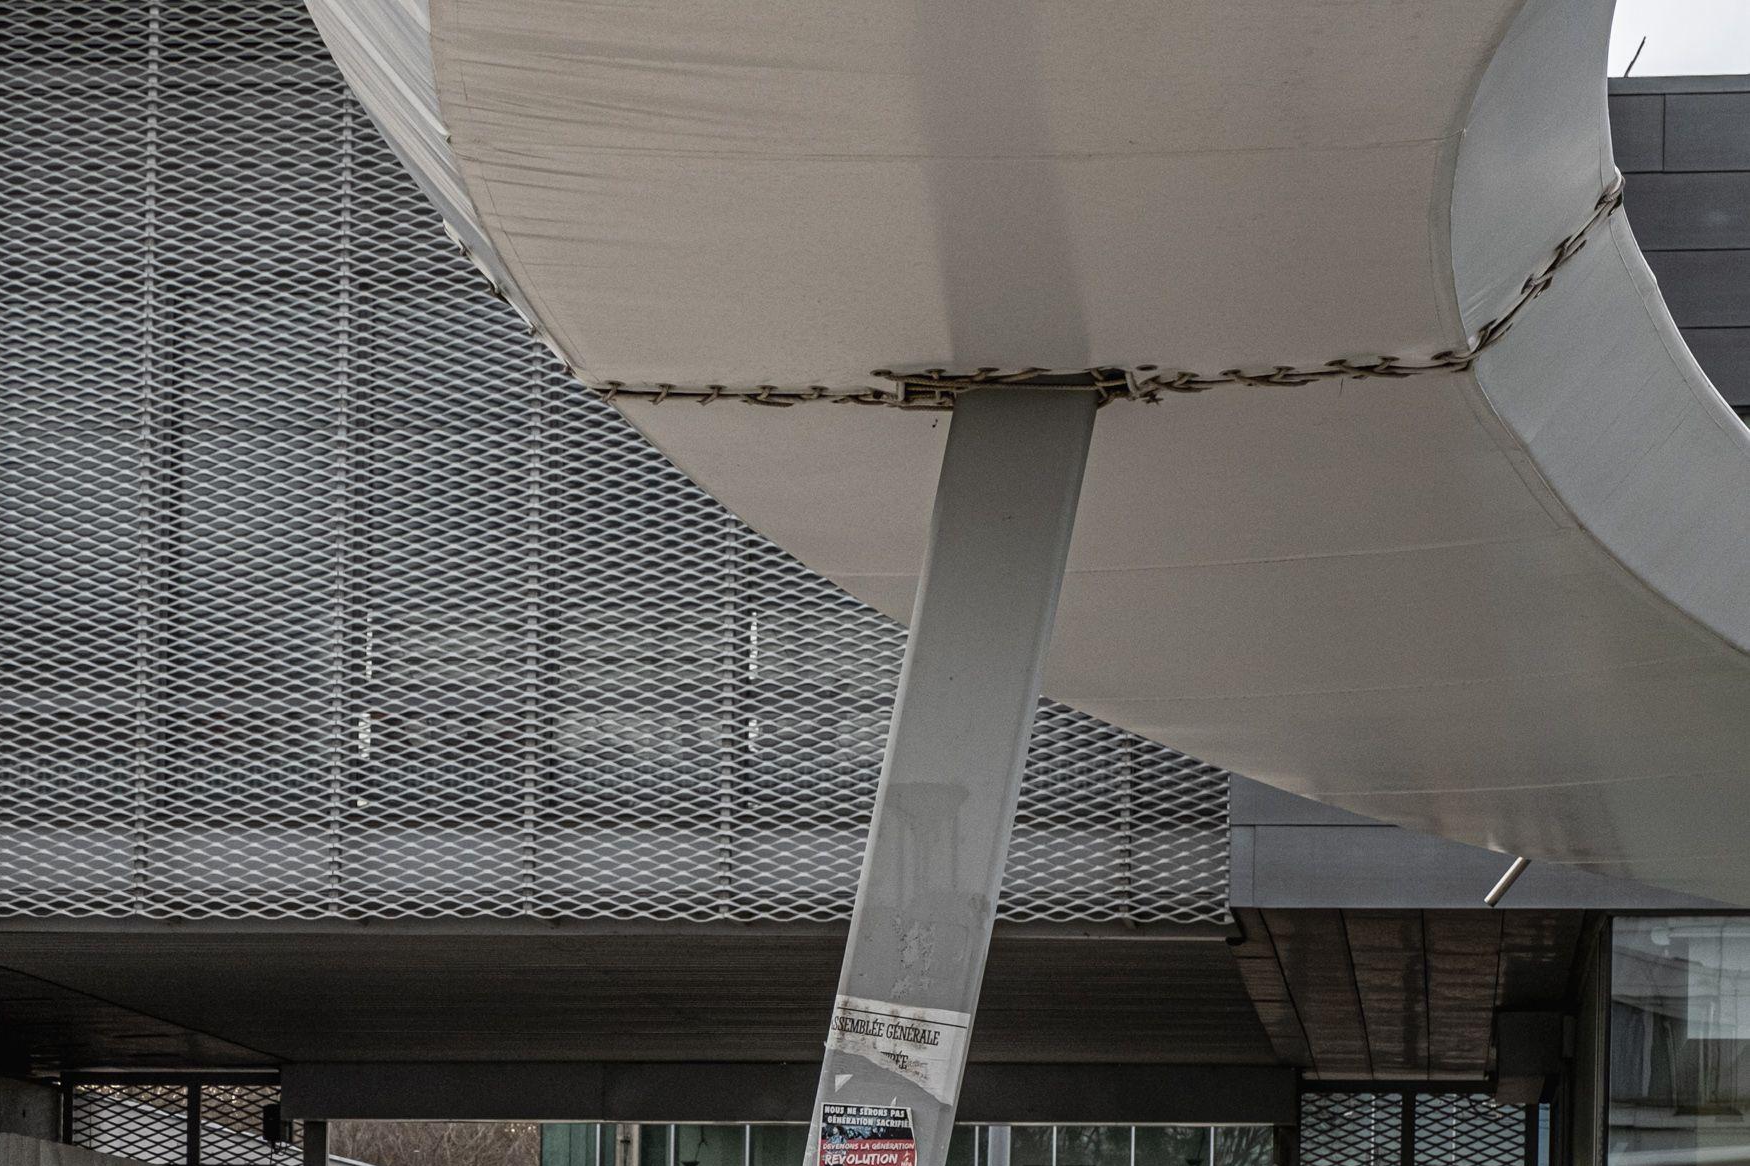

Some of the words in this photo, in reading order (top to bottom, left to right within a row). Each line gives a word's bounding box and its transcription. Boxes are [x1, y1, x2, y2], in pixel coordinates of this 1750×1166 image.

[831, 1016, 885, 1038] SSEMBLÉE
[886, 1021, 941, 1046] GÉNÉRALE
[824, 1106, 844, 1114] NOUS
[847, 1107, 856, 1115] NE
[890, 1109, 904, 1118] PAS
[827, 1114, 873, 1126] GÉNÉRATION
[872, 1142, 915, 1150] GÉNÉRATION
